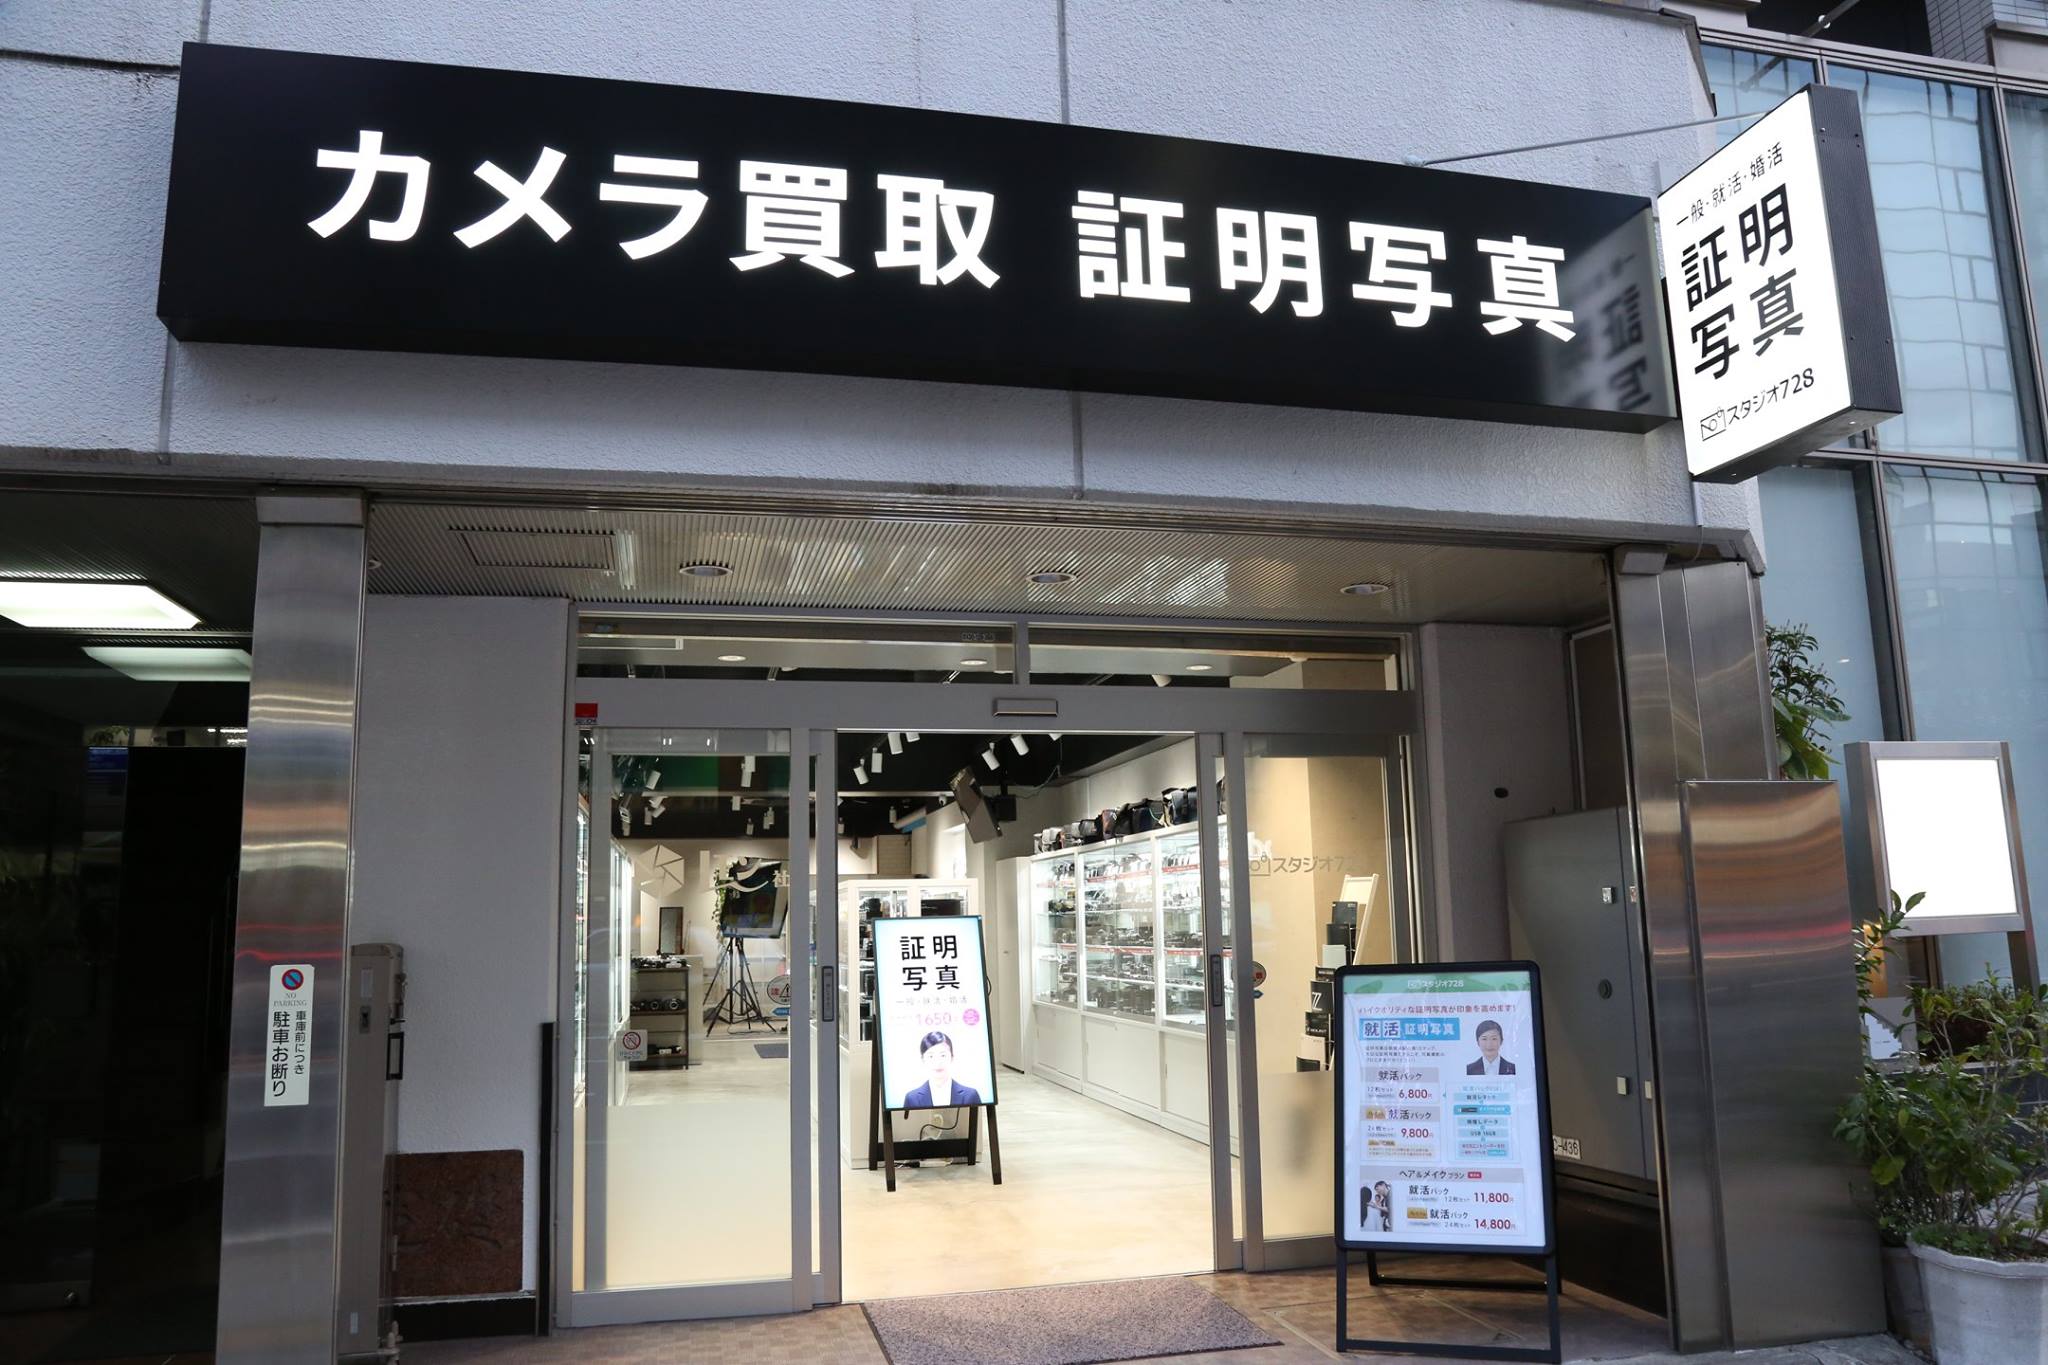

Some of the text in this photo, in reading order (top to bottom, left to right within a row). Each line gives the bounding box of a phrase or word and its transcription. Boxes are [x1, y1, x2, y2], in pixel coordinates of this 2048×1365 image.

[1676, 141, 1784, 227] 一般・就活・婚活
[307, 130, 1577, 342] カメラ買取 証明写真
[1681, 183, 1795, 312] 証明
[1690, 267, 1805, 380] 写真
[1726, 367, 1816, 426] スタジオ728
[899, 935, 959, 961] 証明
[902, 964, 961, 992] 写真
[271, 1011, 291, 1098] 駐車お断り
[294, 1010, 307, 1076] 車庫前につき
